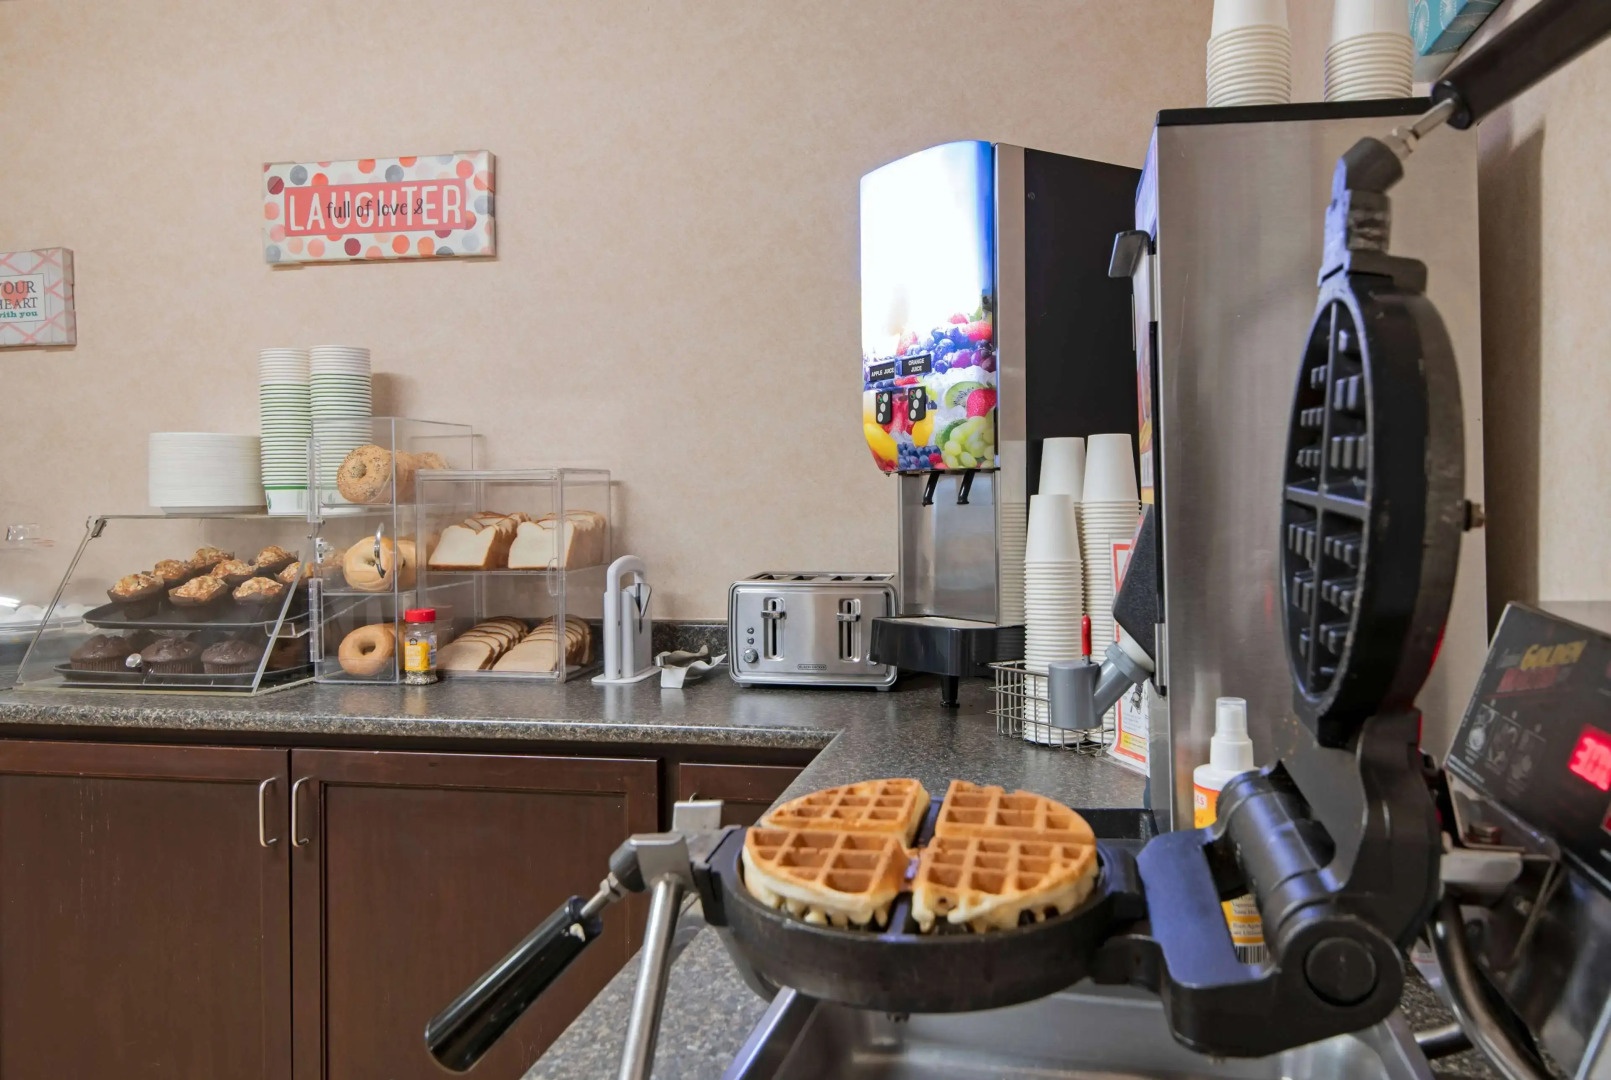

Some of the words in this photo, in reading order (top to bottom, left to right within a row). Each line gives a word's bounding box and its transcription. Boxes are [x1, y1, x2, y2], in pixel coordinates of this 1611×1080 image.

[289, 185, 461, 231] LAUGHTER
[326, 200, 350, 219] full
[356, 200, 372, 218] of
[377, 199, 408, 216] love
[0, 281, 36, 294] OUR
[19, 311, 38, 319] you
[908, 358, 925, 366] ORANGE
